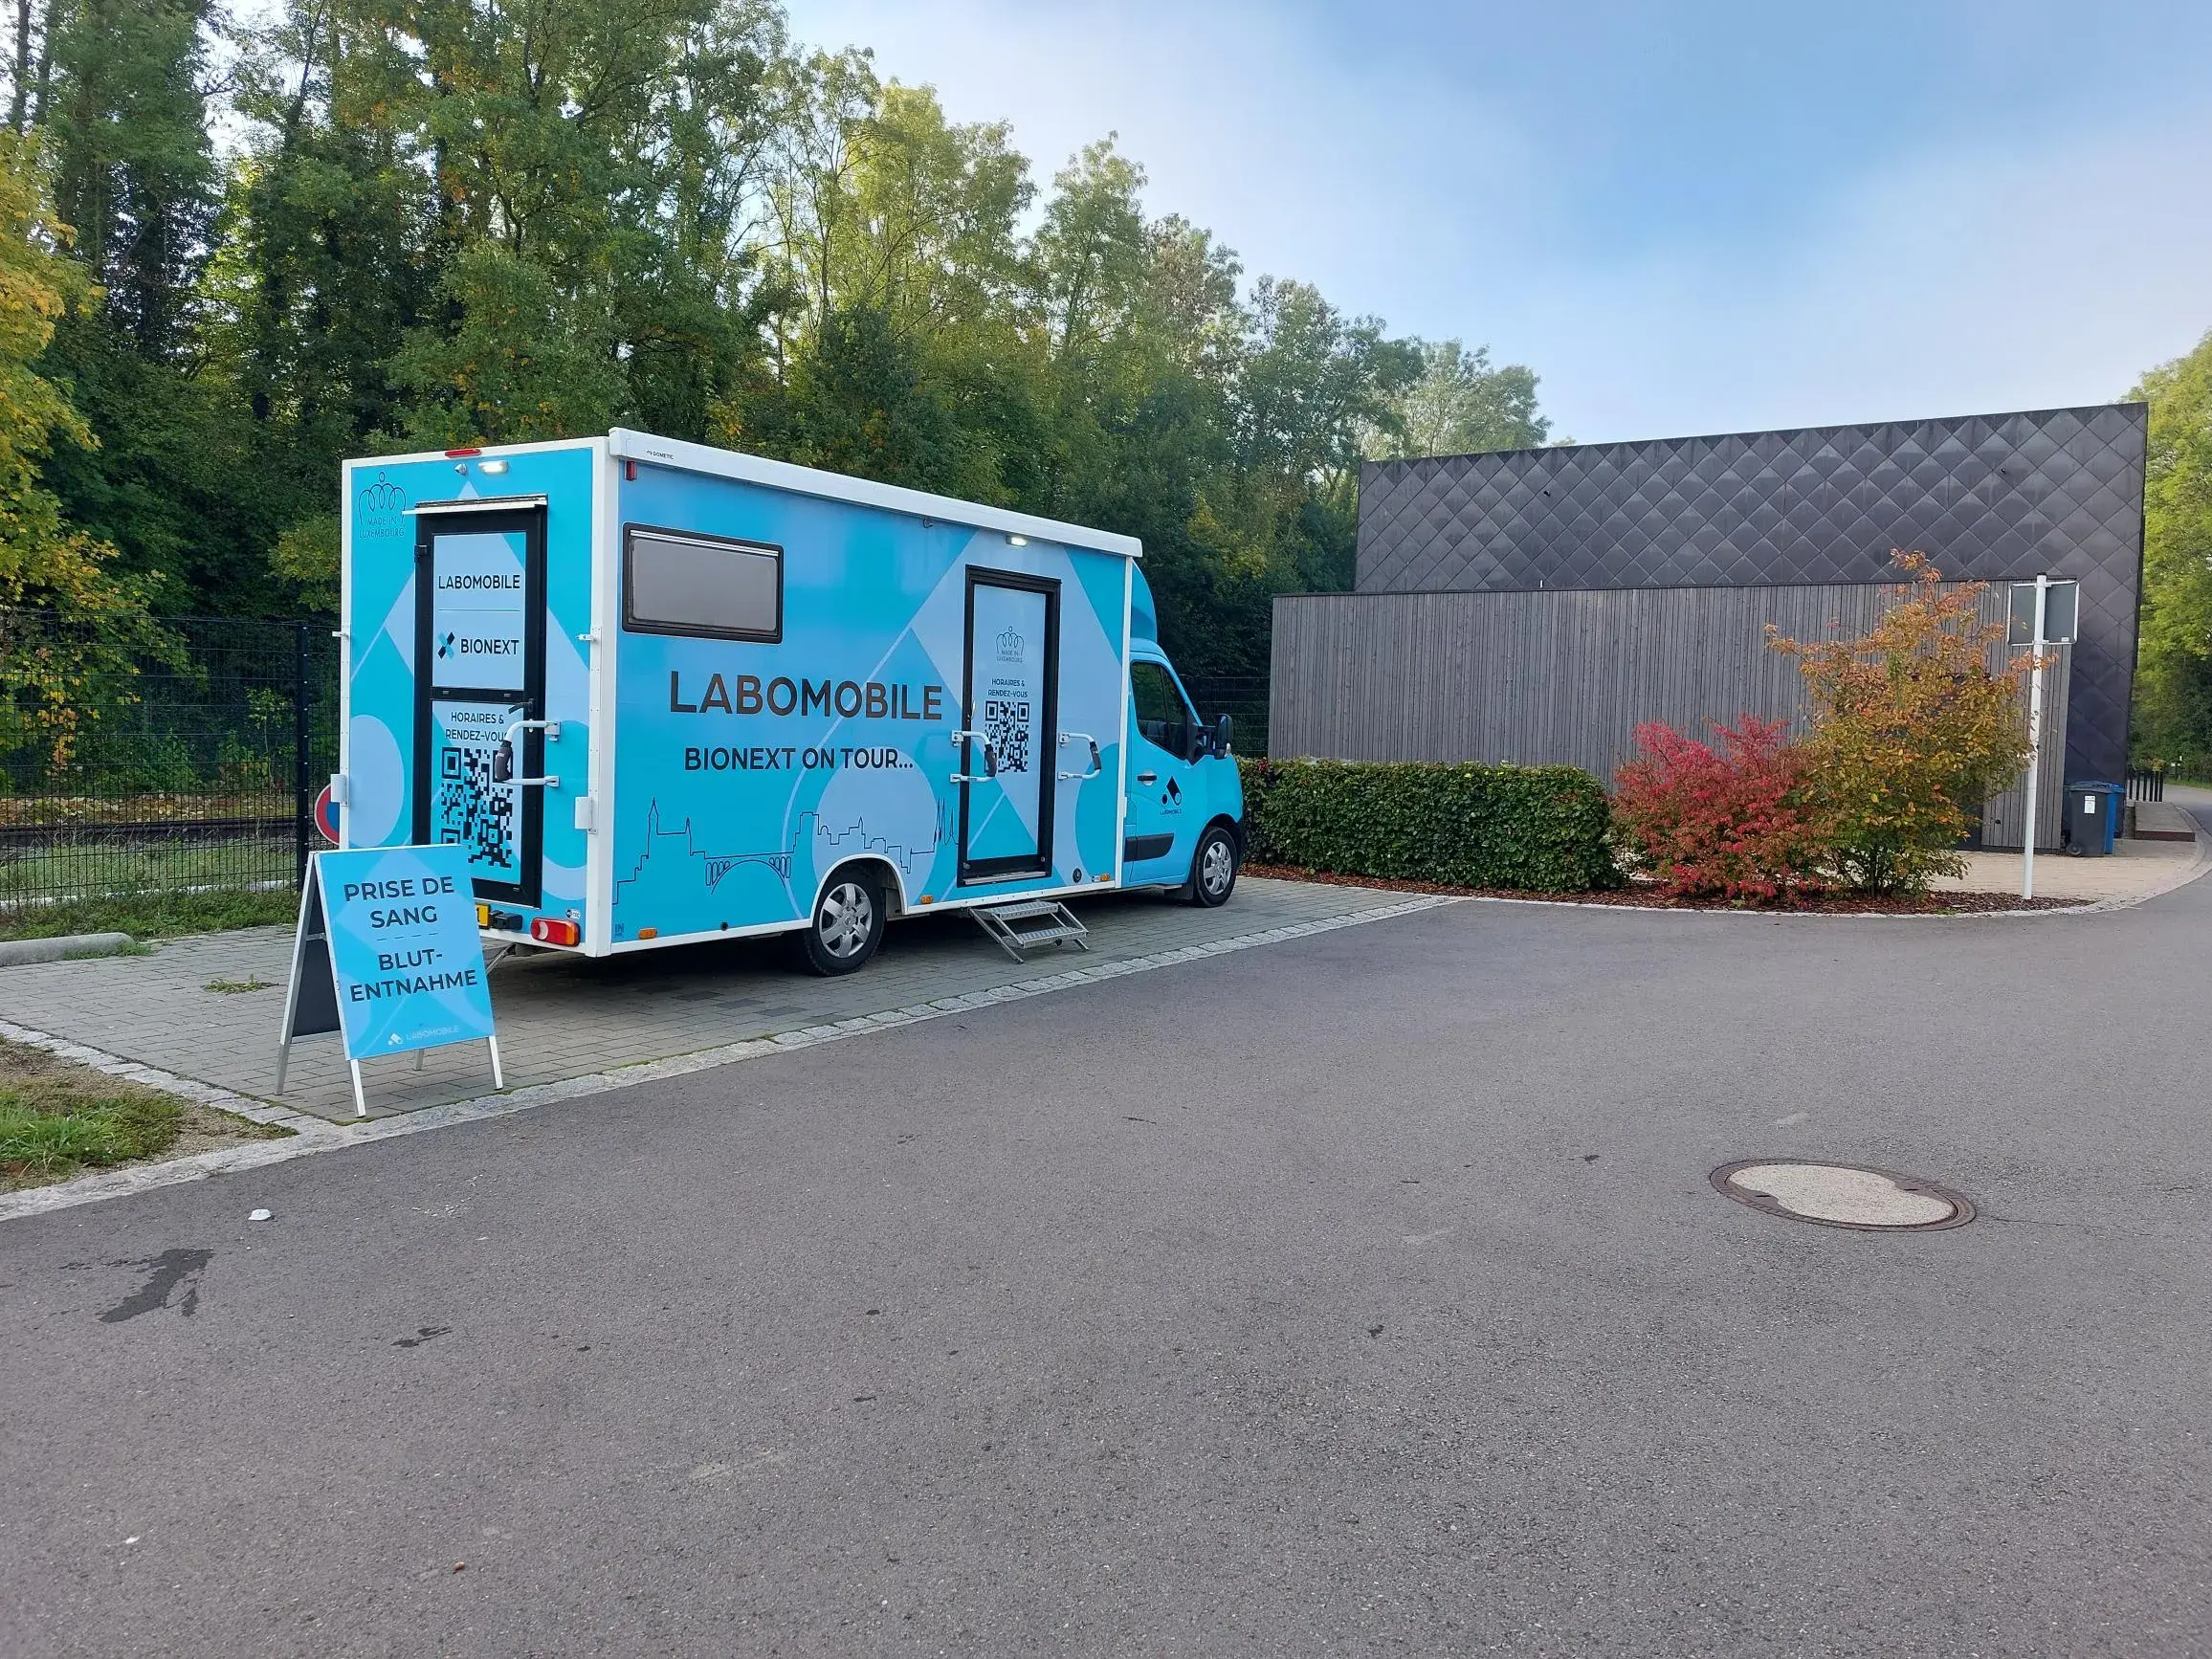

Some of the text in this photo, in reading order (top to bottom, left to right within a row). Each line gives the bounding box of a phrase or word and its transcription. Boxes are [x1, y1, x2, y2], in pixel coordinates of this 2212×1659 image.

[653, 451, 674, 460] DOMETIC
[359, 528, 405, 538] LUXEMBOURG
[438, 575, 520, 589] LABOMOBILE
[460, 639, 520, 654] BIONEXT
[991, 678, 1020, 687] HORAIRES
[671, 671, 942, 720] LABOMOBILE
[987, 689, 1029, 697] RENDEZ-VOUS
[451, 712, 504, 724] HORAIRES &
[684, 747, 914, 771] BIONEXT ON TOUR...
[343, 876, 454, 902] PRISE DE
[369, 905, 438, 929] SANG
[378, 948, 443, 971] BLUT-
[349, 969, 478, 1003] ENTNAHME
[406, 1025, 460, 1041] LABOMOBILE
